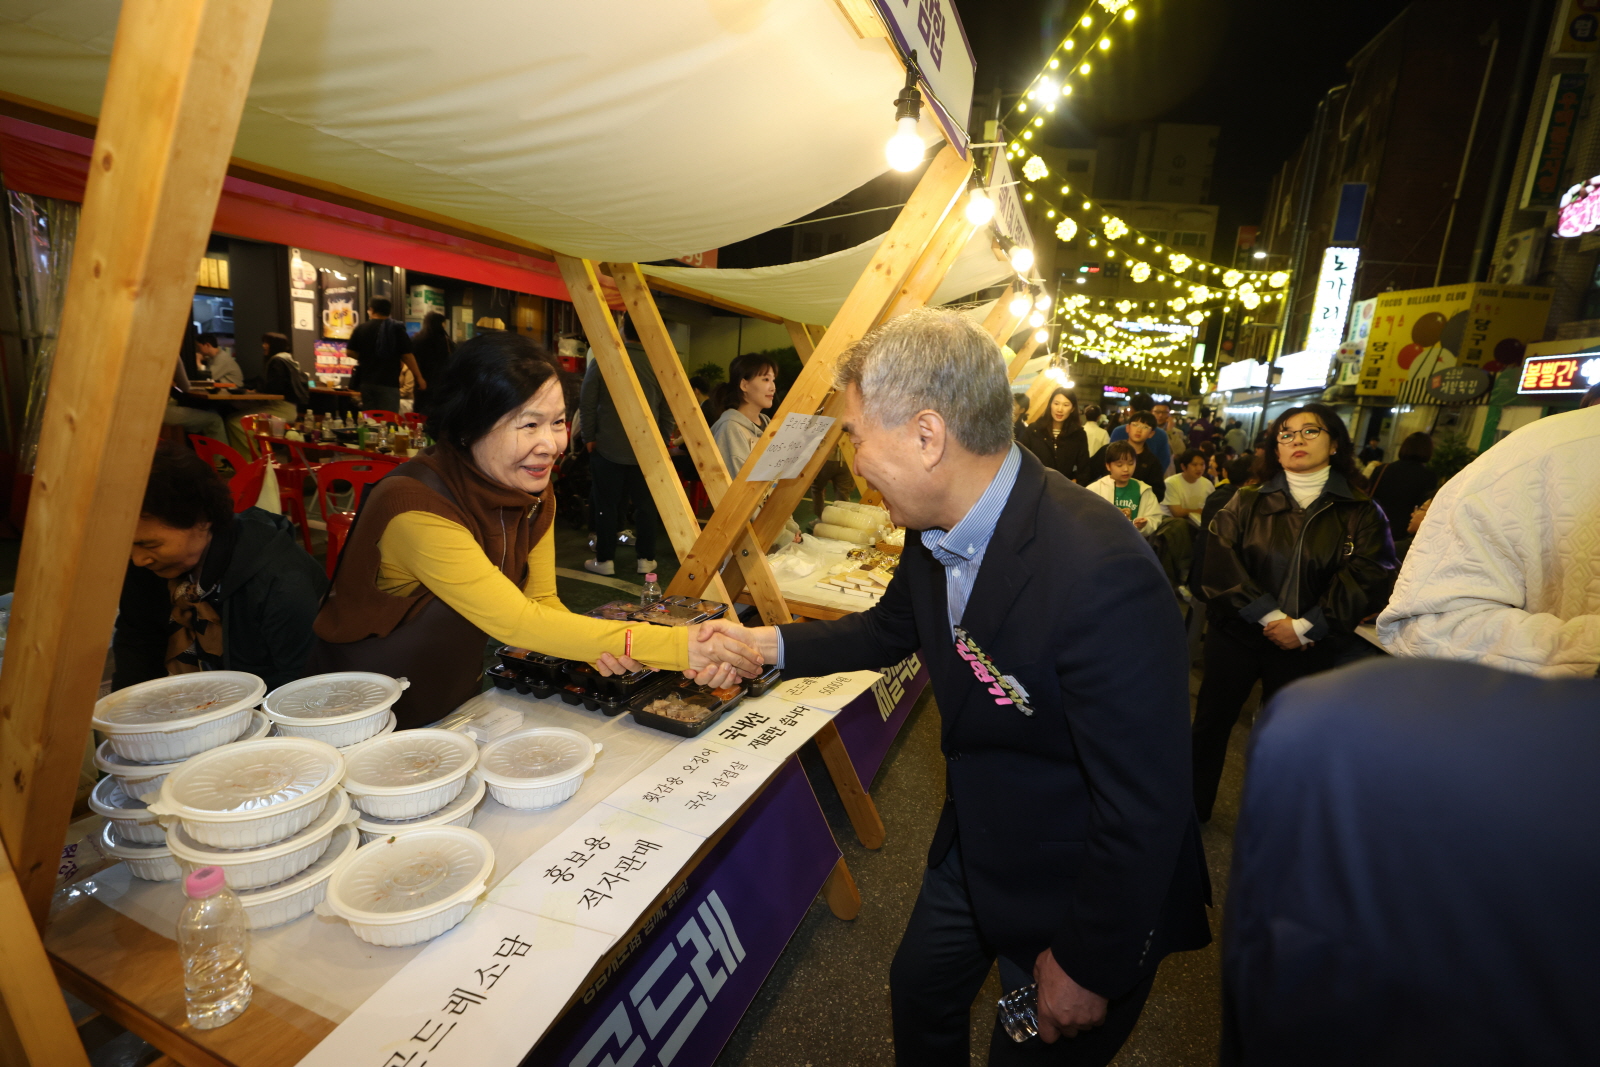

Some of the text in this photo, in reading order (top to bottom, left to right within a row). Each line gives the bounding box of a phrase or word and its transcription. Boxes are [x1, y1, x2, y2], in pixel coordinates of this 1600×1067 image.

[1322, 254, 1348, 320] 노가리
[1380, 290, 1467, 308] FOCUS BILLIARD CLUB
[819, 676, 852, 696] 5000원
[718, 712, 771, 740] 국내산
[747, 705, 811, 750] 재료만 씁니다
[642, 748, 719, 804] 횟감용 오징어
[685, 760, 749, 811] 국산 삼겹살
[543, 836, 611, 885] 홍보용
[577, 839, 663, 910] 적자판매
